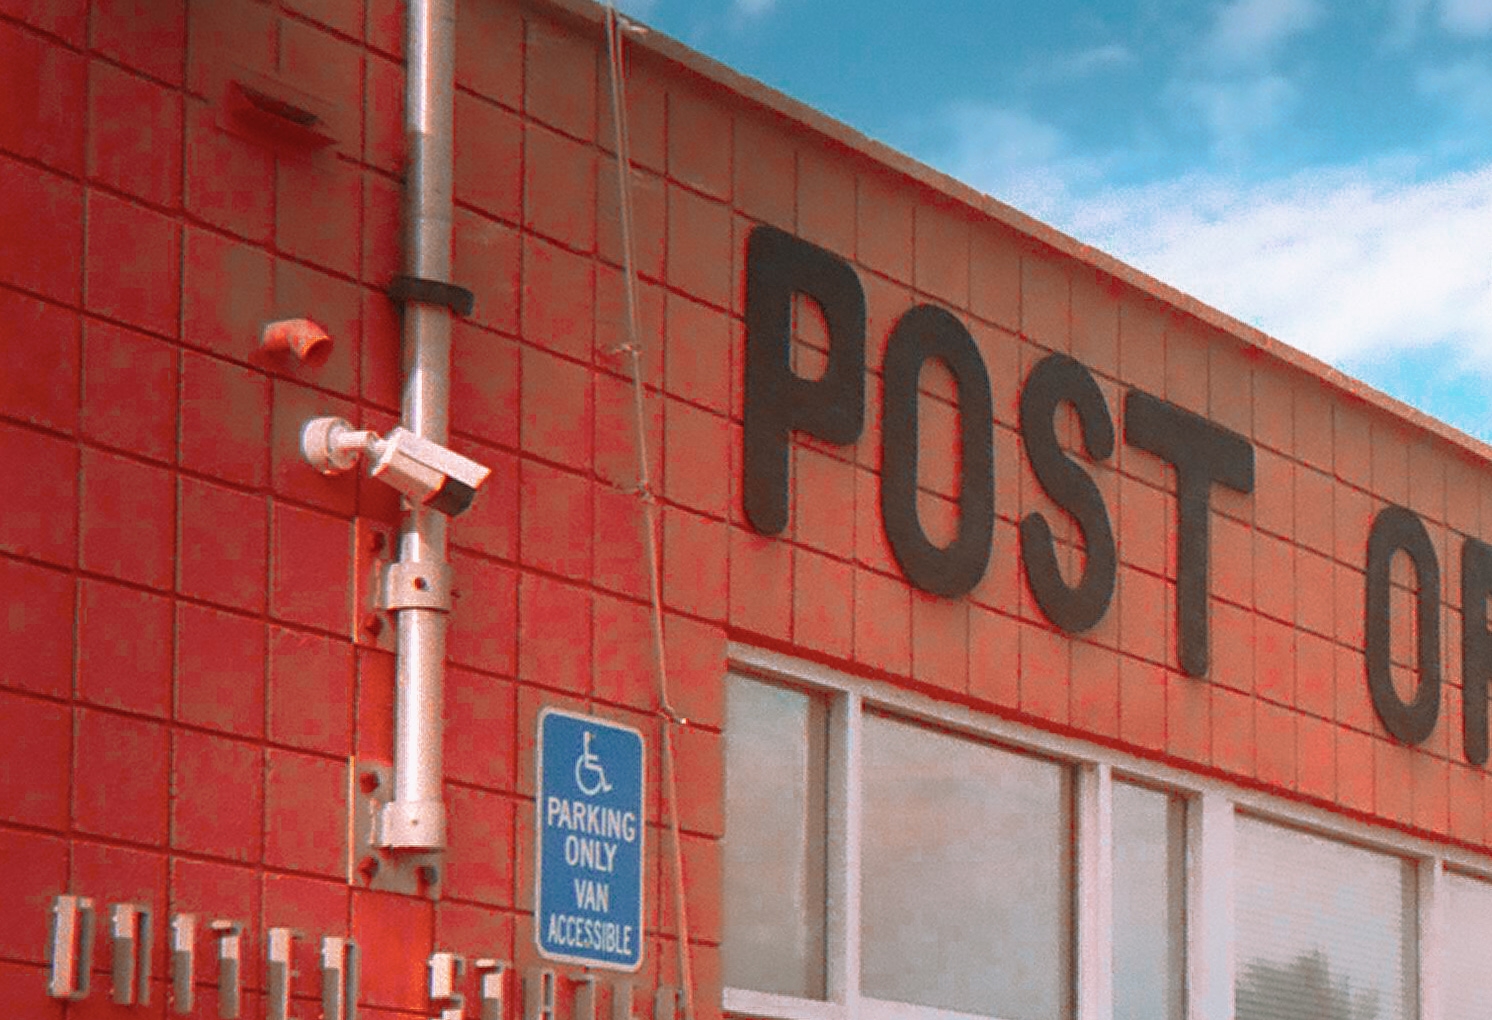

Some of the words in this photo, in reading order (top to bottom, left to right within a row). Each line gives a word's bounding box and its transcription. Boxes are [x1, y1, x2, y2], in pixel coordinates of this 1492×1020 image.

[742, 223, 1254, 679] POST
[547, 796, 636, 842] PARKING
[565, 835, 617, 873] ONLY
[574, 878, 609, 913] VAN
[548, 913, 632, 955] ACCESSIBLE
